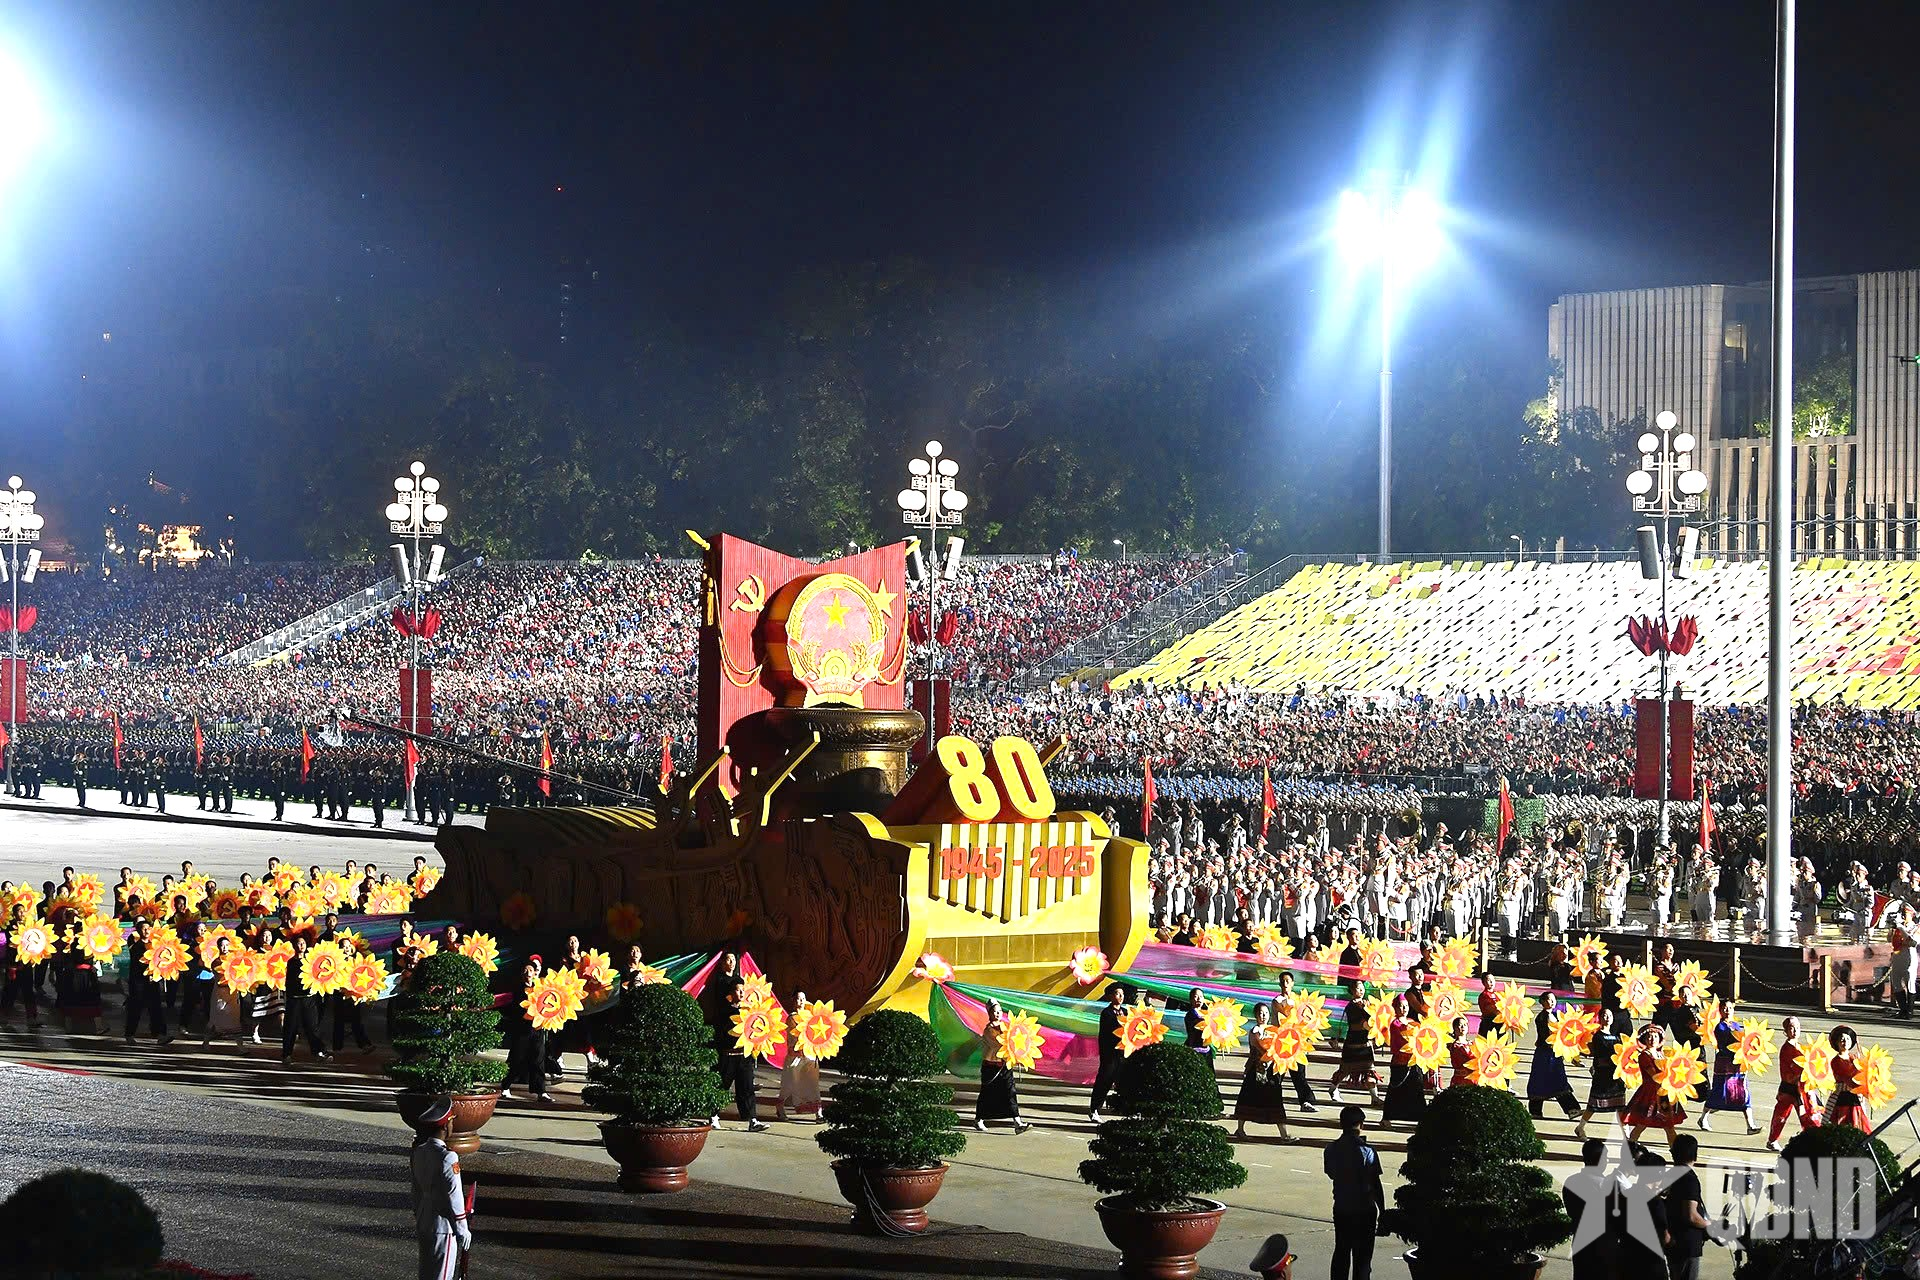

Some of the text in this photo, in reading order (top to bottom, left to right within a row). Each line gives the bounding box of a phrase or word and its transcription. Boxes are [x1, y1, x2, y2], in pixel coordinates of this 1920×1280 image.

[937, 735, 1056, 821] 80
[940, 847, 1003, 880] 1945
[1030, 845, 1095, 878] 2025
